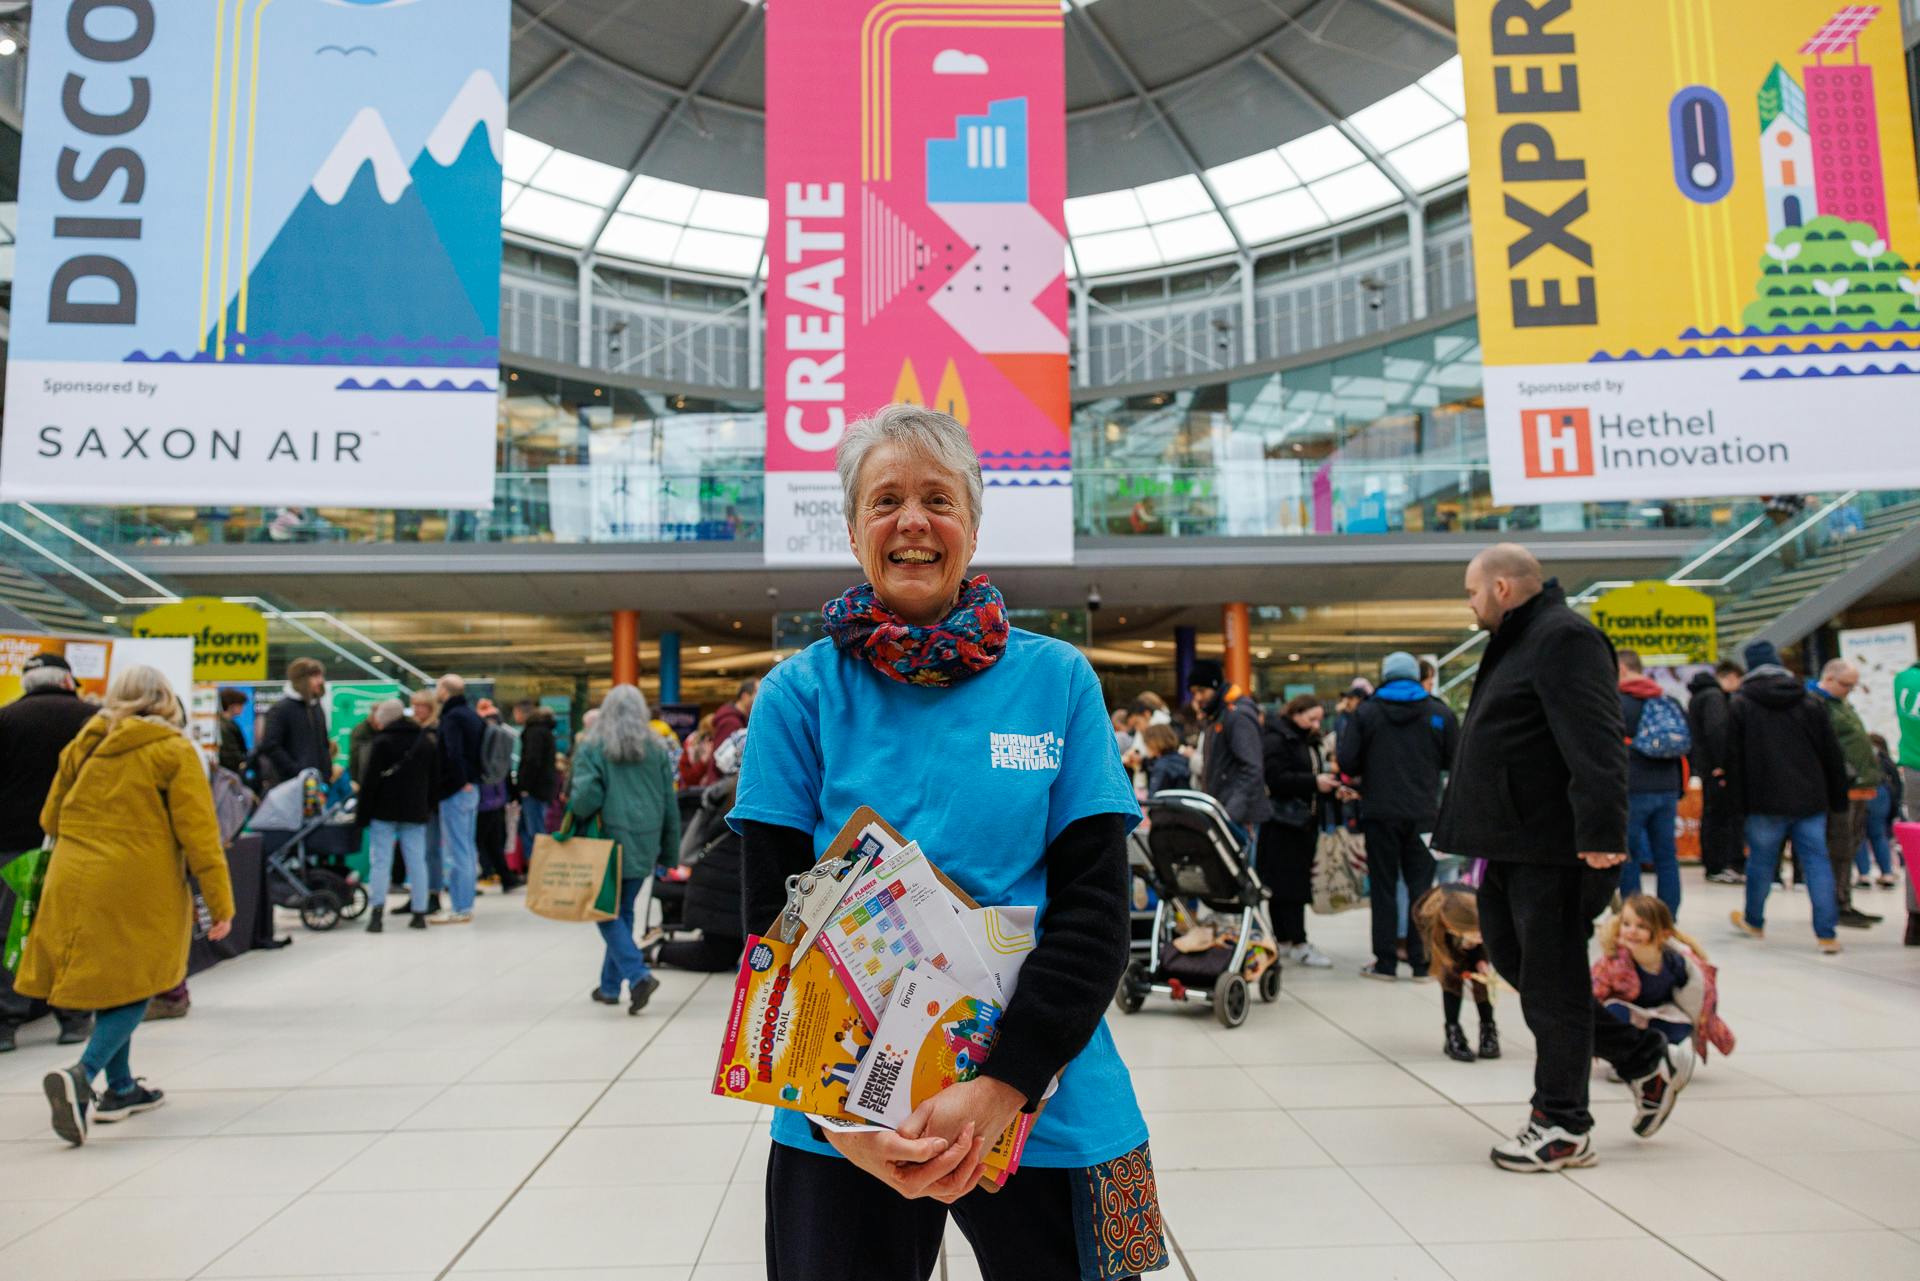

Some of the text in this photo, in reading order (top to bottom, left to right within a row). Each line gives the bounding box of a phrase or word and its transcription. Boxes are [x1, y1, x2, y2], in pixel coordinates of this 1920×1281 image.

[785, 182, 845, 452] CREATE
[43, 377, 158, 397] Sponsored by
[1518, 378, 1625, 396] Sponsored by
[1601, 409, 1715, 440] Hethel
[37, 426, 363, 463] SAXON AIR
[1601, 440, 1789, 470] Innovation
[1596, 608, 1709, 628] Transform
[1606, 633, 1711, 648] omorrow
[990, 731, 1054, 748] NORWICH
[990, 745, 1048, 760] SCIENCE
[991, 756, 1058, 771] FESTIVAL
[731, 1001, 743, 1030] FEBRUARY
[748, 979, 770, 1059] MARVELLOUS
[775, 1009, 790, 1042] TRAIL
[857, 1050, 887, 1108] NORWICH
[866, 1060, 893, 1111] SCIENCE
[875, 1056, 905, 1114] FESTIVAL
